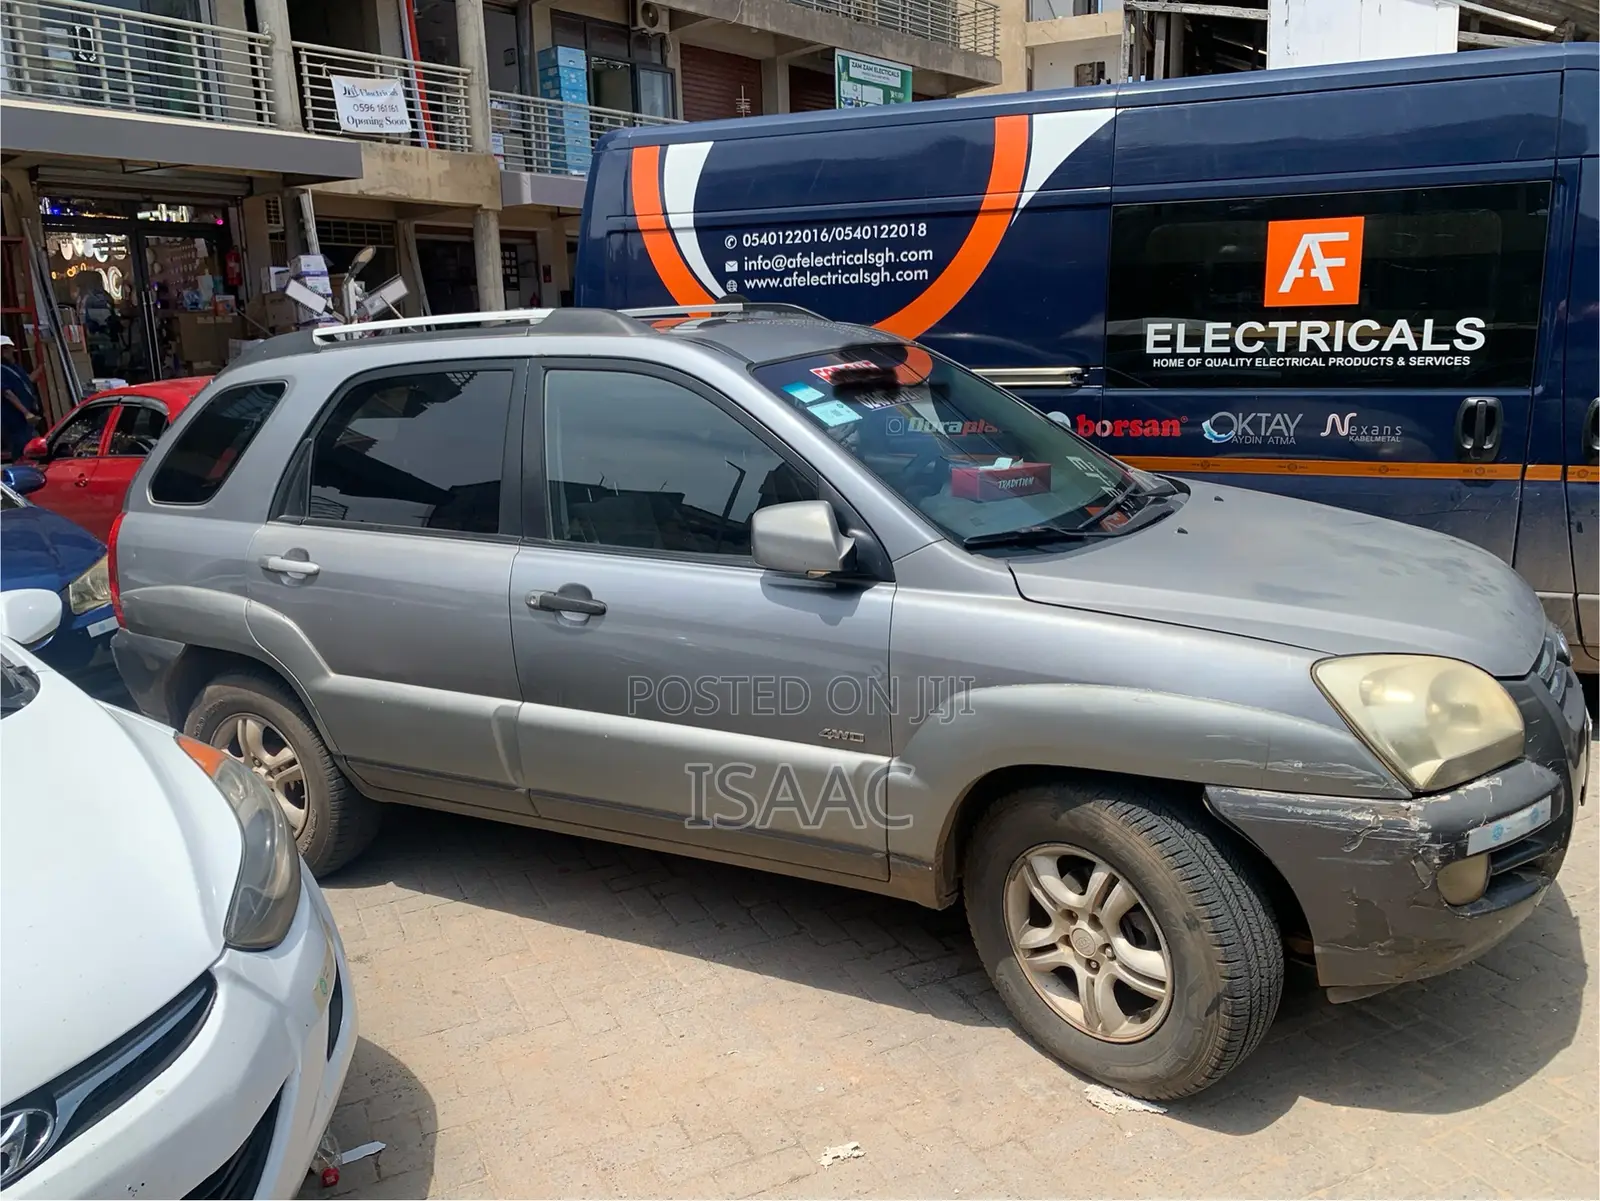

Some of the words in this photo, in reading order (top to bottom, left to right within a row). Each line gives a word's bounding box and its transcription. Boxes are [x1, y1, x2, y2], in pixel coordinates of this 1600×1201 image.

[353, 103, 375, 112] 0596
[346, 115, 384, 128] Opening
[385, 116, 407, 126] Soon
[742, 223, 927, 248] 0540122016/0540122018
[744, 247, 934, 271] info@afelectricalsgh.com
[1277, 231, 1350, 293] AF
[744, 267, 929, 289] www.afelectricalsgh.com
[1145, 317, 1486, 354] ELECTRICALS
[1153, 358, 1184, 368] HOME
[1187, 358, 1202, 368] OF
[1205, 358, 1252, 367] QUALITY
[1255, 357, 1326, 367] ELECTRICAL
[1328, 357, 1394, 366] PRODUCTS
[1396, 357, 1406, 366] &
[1408, 356, 1471, 366] SERVICES
[1076, 414, 1182, 437] borsan
[1208, 411, 1304, 437] OKTAY
[1320, 413, 1403, 436] Nexans
[818, 728, 865, 743] 4WD
